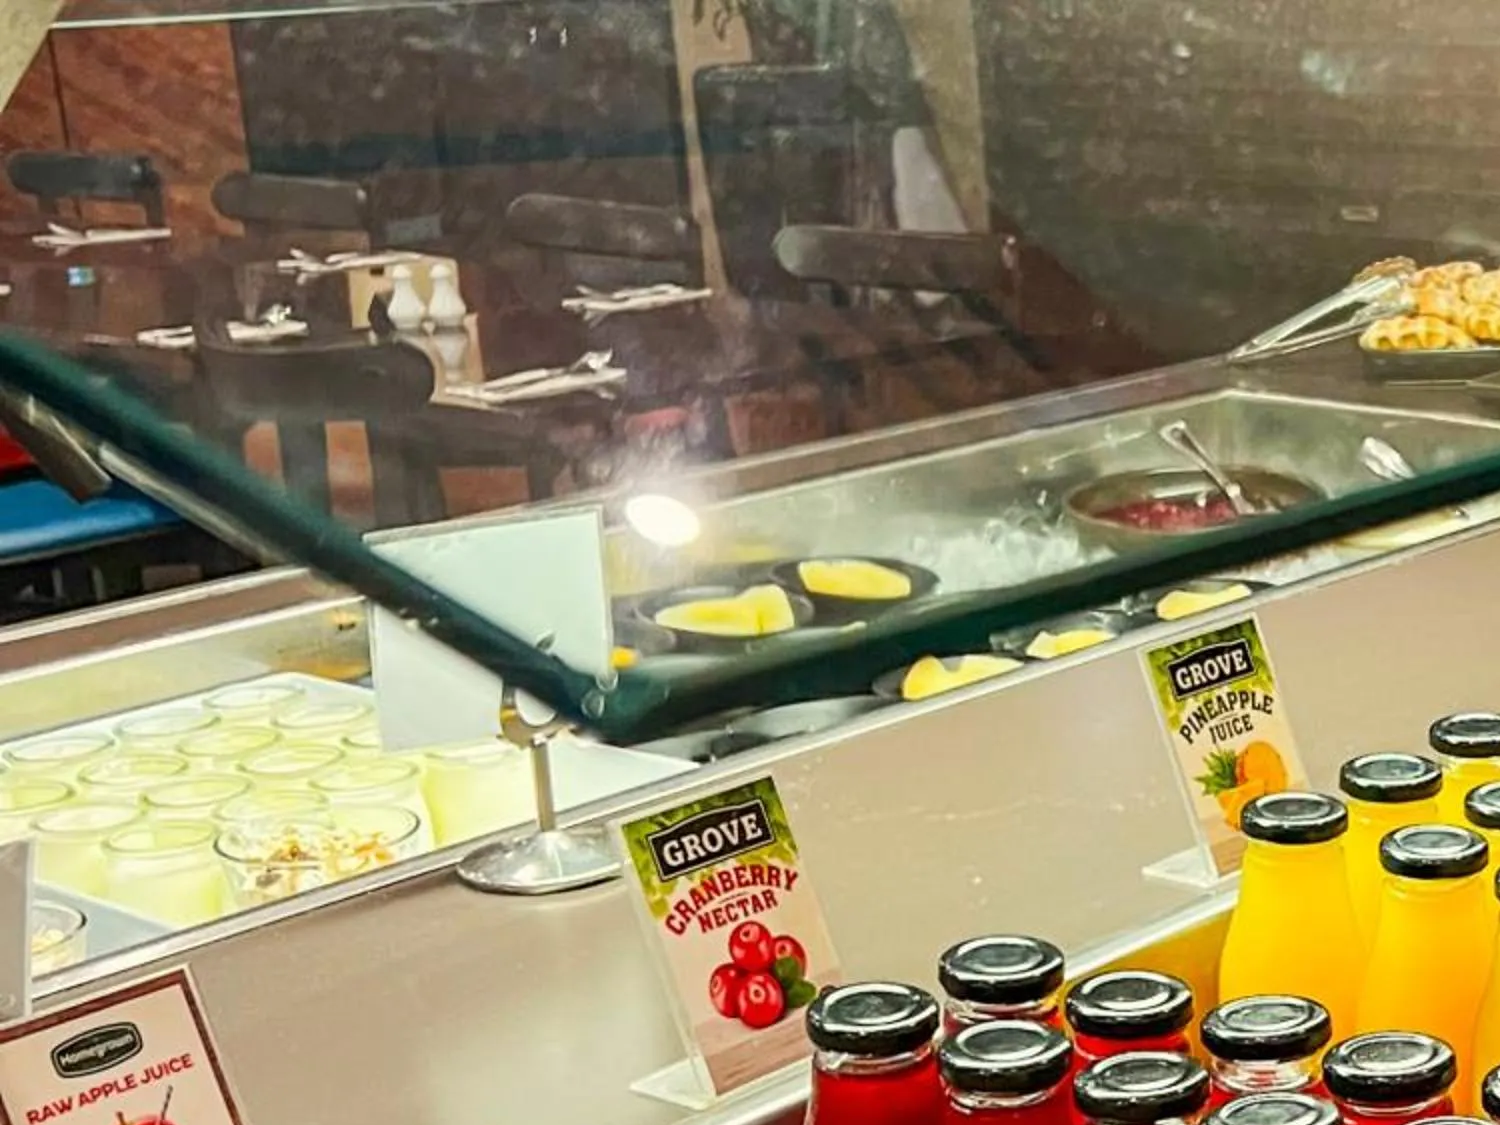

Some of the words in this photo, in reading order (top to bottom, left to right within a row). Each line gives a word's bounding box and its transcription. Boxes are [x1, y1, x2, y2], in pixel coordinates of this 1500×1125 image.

[1175, 649, 1248, 690] GROVE
[1179, 690, 1274, 745] PINEAPPLE
[1209, 714, 1254, 744] JUICE
[663, 813, 763, 867] GROVE
[665, 863, 799, 936] CRANBERRY
[699, 890, 778, 933] NECTAR
[26, 1096, 73, 1125] RAW
[78, 1073, 138, 1107] APPLE
[140, 1053, 194, 1084] JUICE
